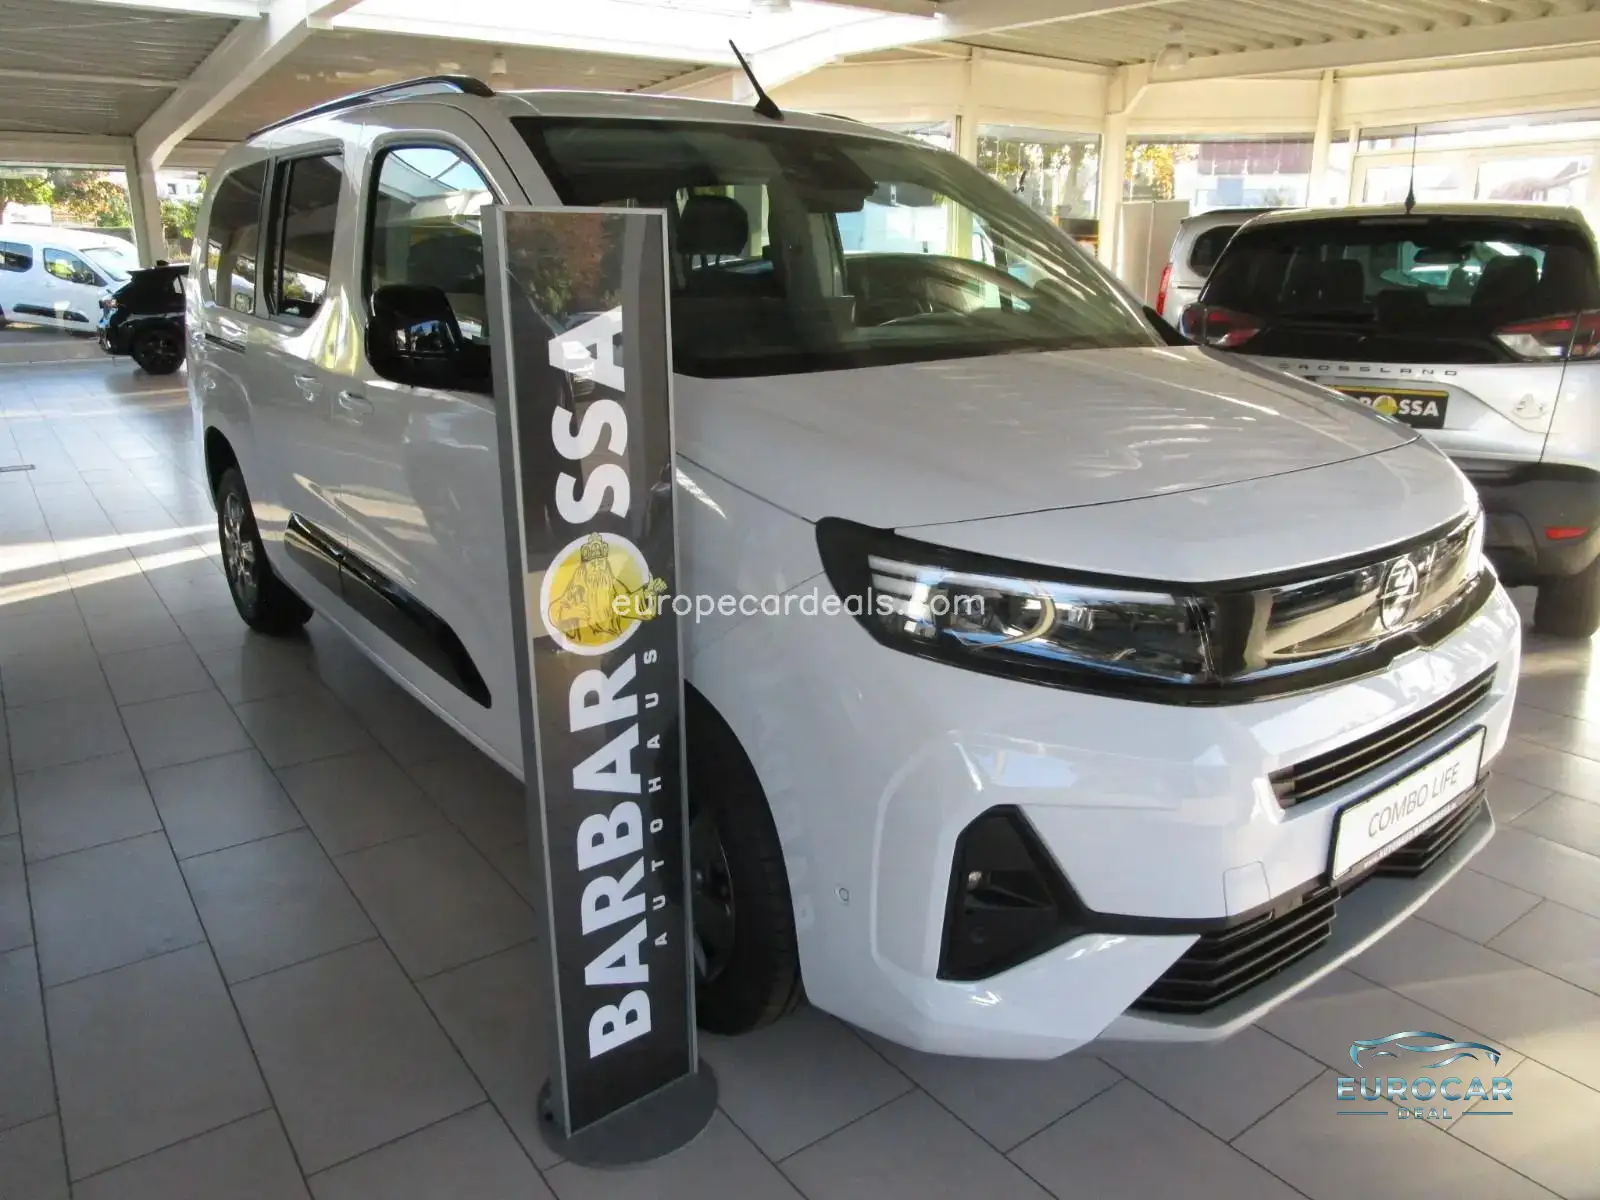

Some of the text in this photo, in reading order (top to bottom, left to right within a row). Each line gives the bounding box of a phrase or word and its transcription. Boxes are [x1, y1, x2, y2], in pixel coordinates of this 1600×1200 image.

[1278, 362, 1458, 376] CROSSLAND
[540, 305, 653, 1058] BARBAROSSA
[643, 648, 669, 947] AUTOHAUS
[1367, 783, 1429, 838] COMBO
[1431, 761, 1460, 799] LIFE
